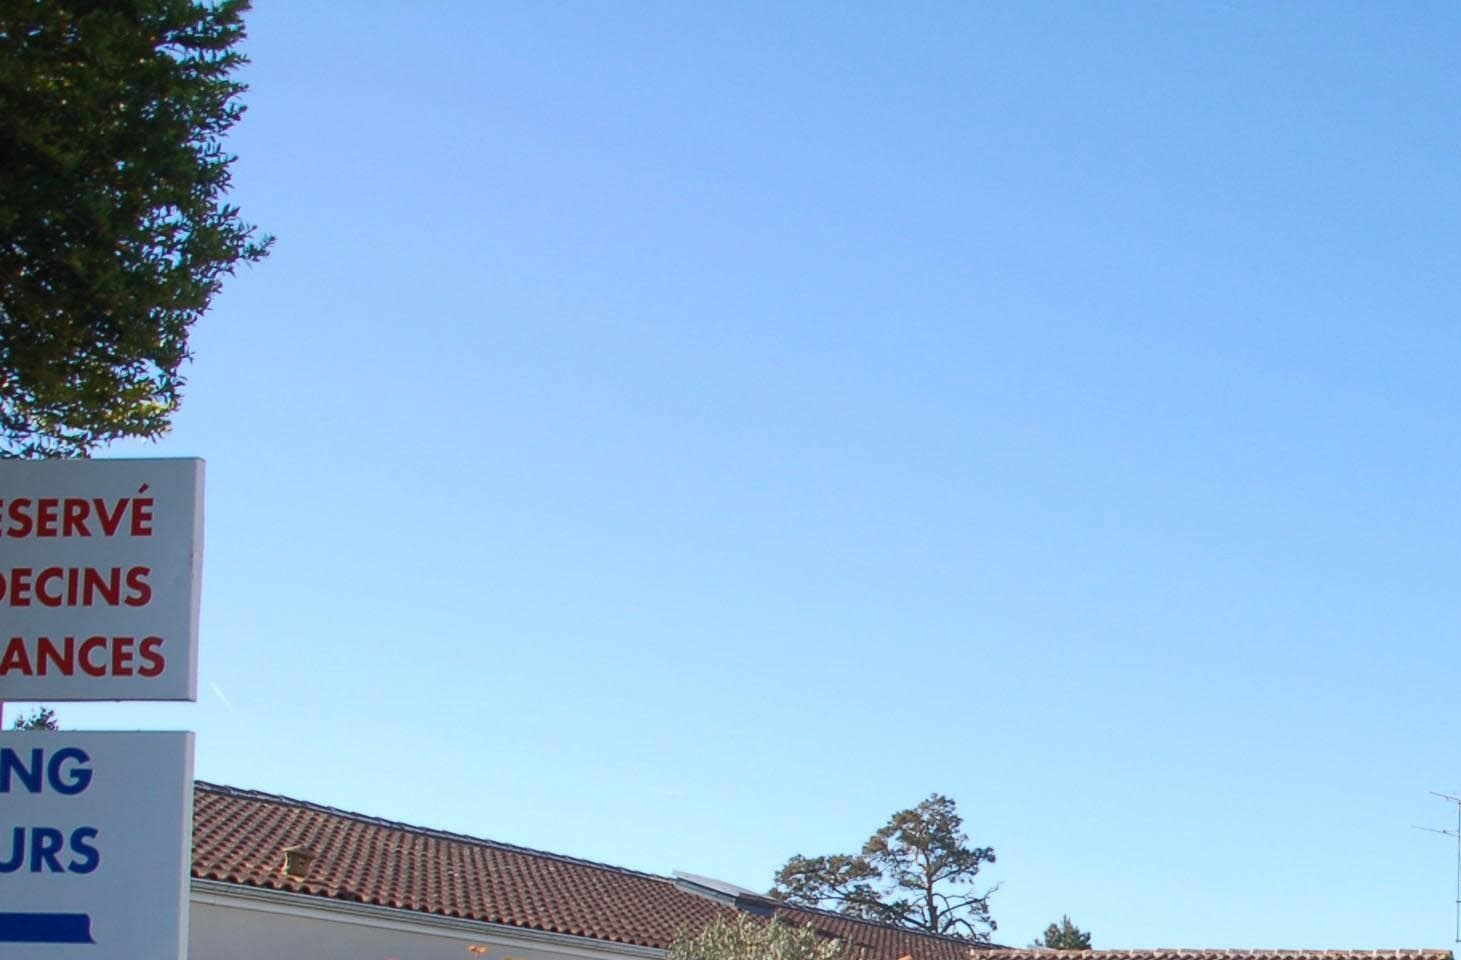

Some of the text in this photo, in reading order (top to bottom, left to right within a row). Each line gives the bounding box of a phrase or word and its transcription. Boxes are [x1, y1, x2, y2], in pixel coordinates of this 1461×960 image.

[0, 483, 154, 538] SERVÉ
[0, 566, 152, 607] ECINS
[0, 636, 165, 677] ANCES
